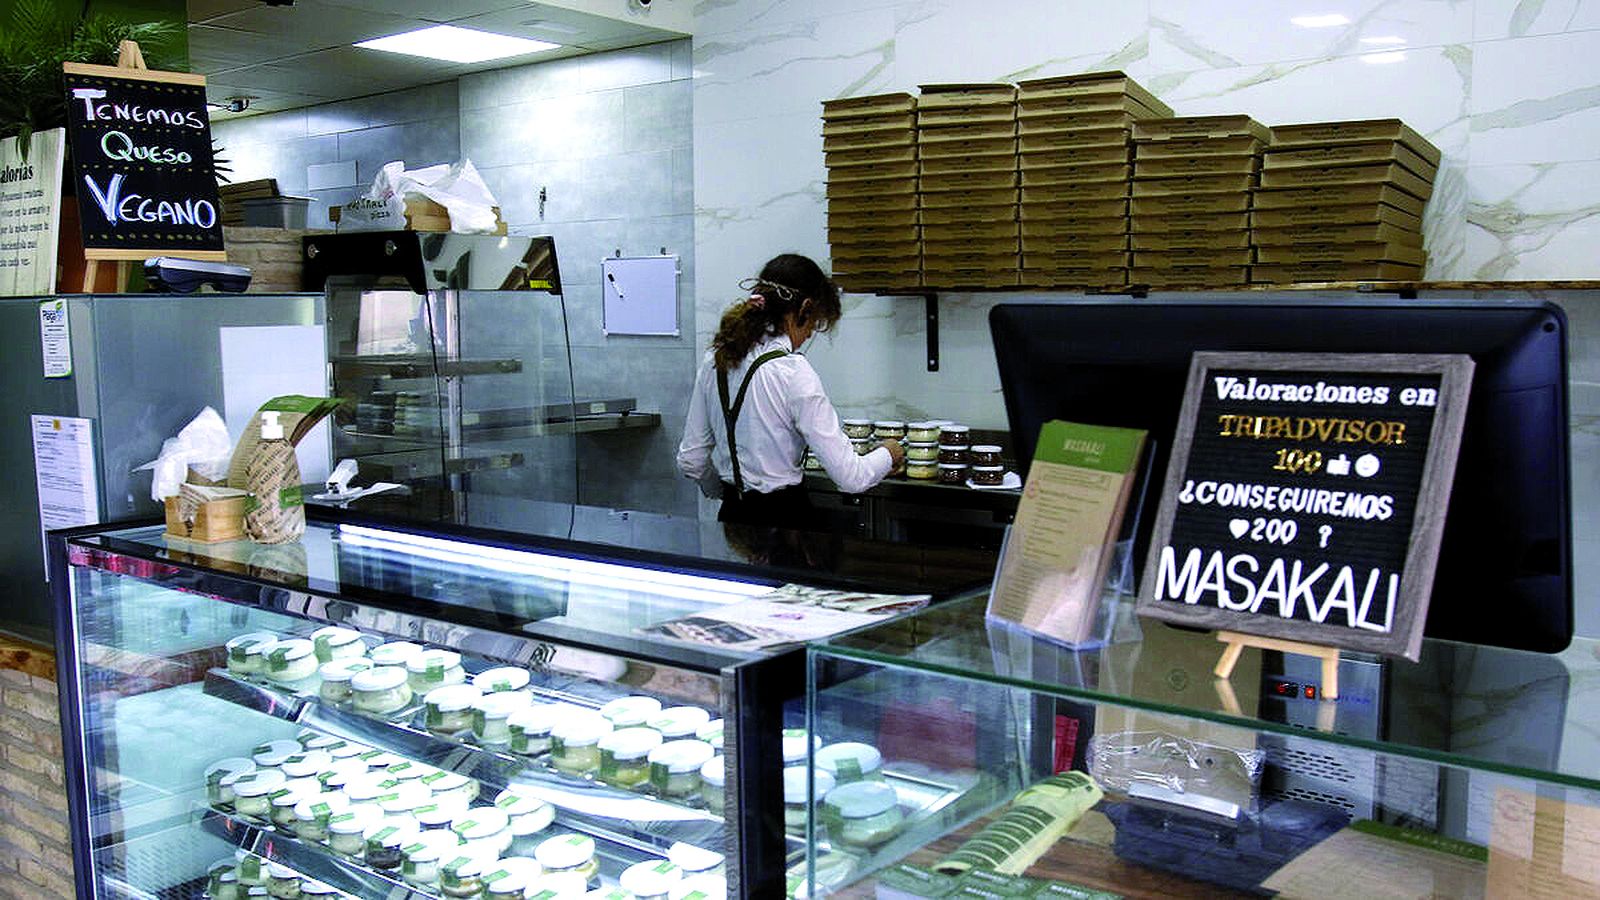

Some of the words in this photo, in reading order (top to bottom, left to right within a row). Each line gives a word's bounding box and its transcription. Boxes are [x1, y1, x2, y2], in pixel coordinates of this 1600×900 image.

[0, 162, 33, 184] alorias
[1214, 377, 1390, 404] Valoraciones
[1400, 387, 1438, 406] en
[1219, 414, 1407, 445] TRIPADVISOR
[1273, 448, 1322, 474] 100
[1178, 480, 1394, 520] ¿CONSEGUIREMOS
[1250, 518, 1298, 545] 200
[1154, 546, 1400, 633] MASAKALI
